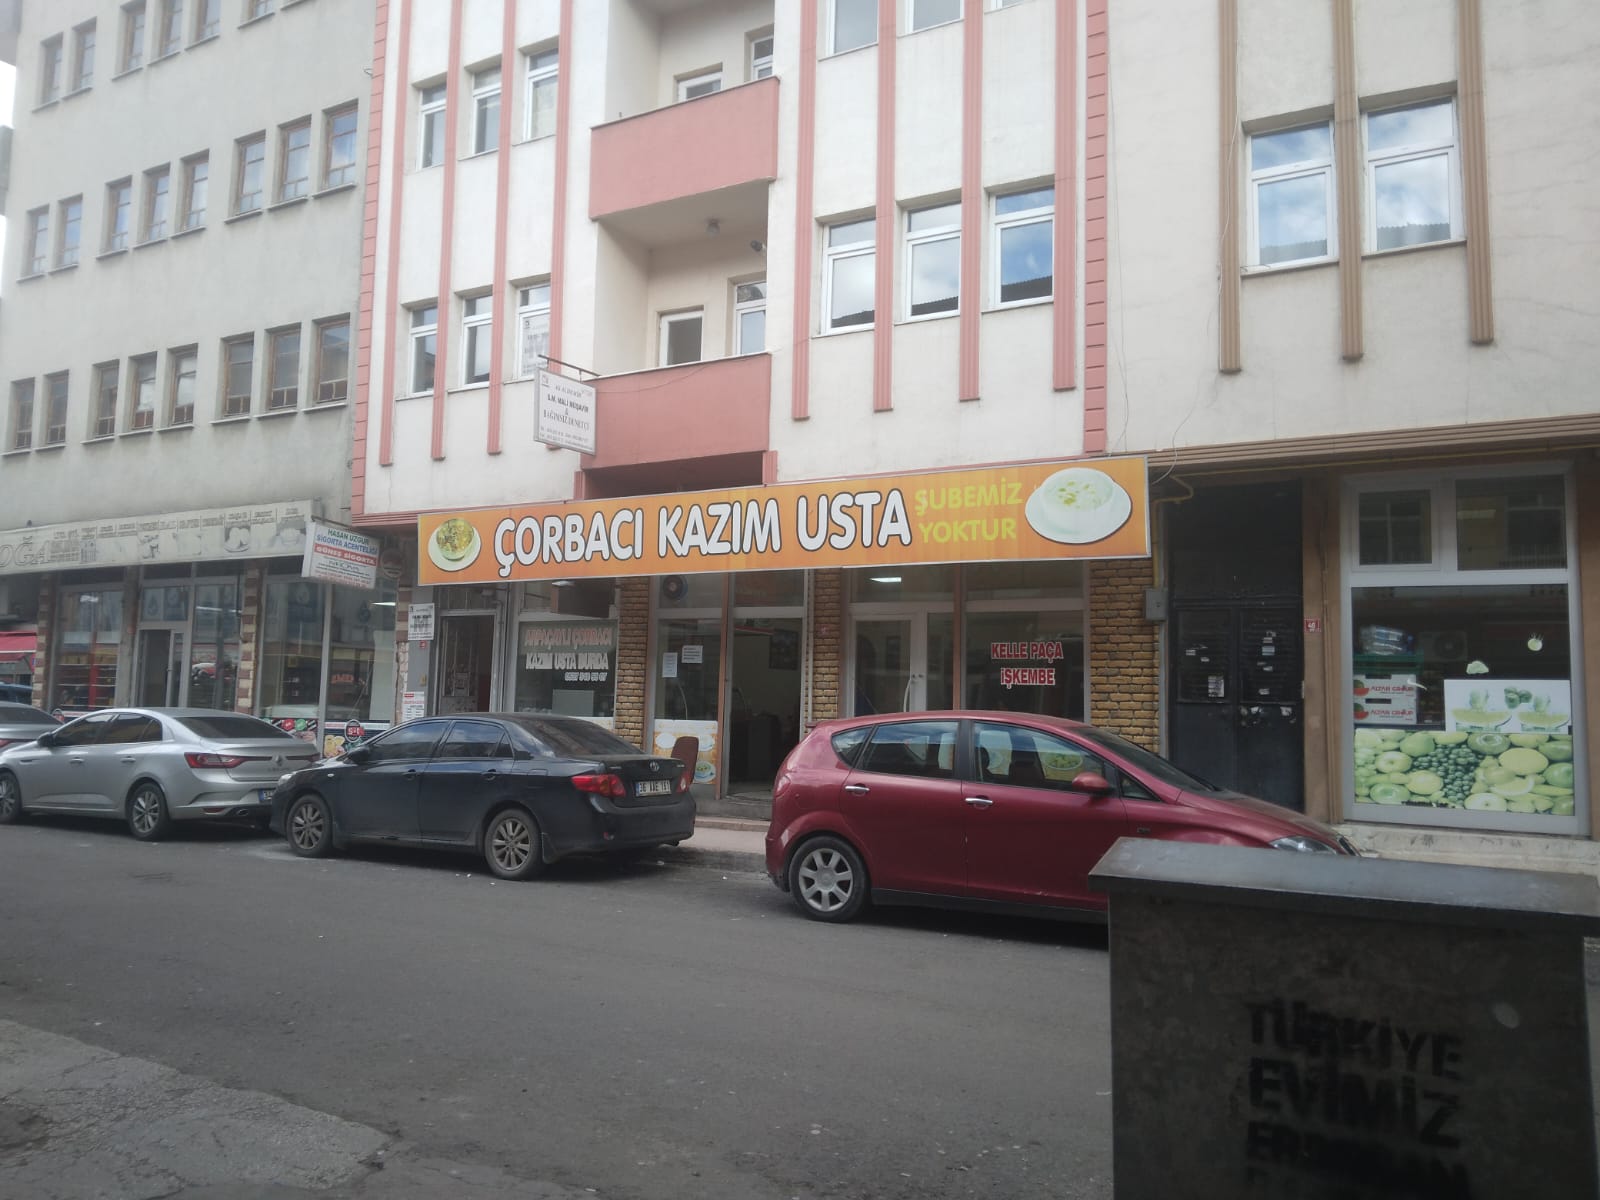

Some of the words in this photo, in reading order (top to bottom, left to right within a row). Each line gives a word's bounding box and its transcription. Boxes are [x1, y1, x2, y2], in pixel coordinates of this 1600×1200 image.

[914, 476, 1024, 517] ŞUBEMİZ
[327, 528, 349, 539] HASAN
[493, 508, 644, 577] ÇORBACI
[657, 498, 782, 559] KAZIM
[796, 488, 912, 552] USTA
[917, 518, 1017, 544] YOKTUR
[343, 551, 376, 565] SİGORTA
[526, 652, 553, 670] KAZIM
[554, 652, 576, 670] USTA
[577, 651, 609, 670] BURDA
[991, 642, 1029, 660] KELLE
[1030, 641, 1064, 664] PAÇA
[1000, 667, 1056, 690] İŞKEMBE
[1244, 998, 1464, 1081] TÜRKİYE
[1247, 1056, 1462, 1151] EVİMİZ
